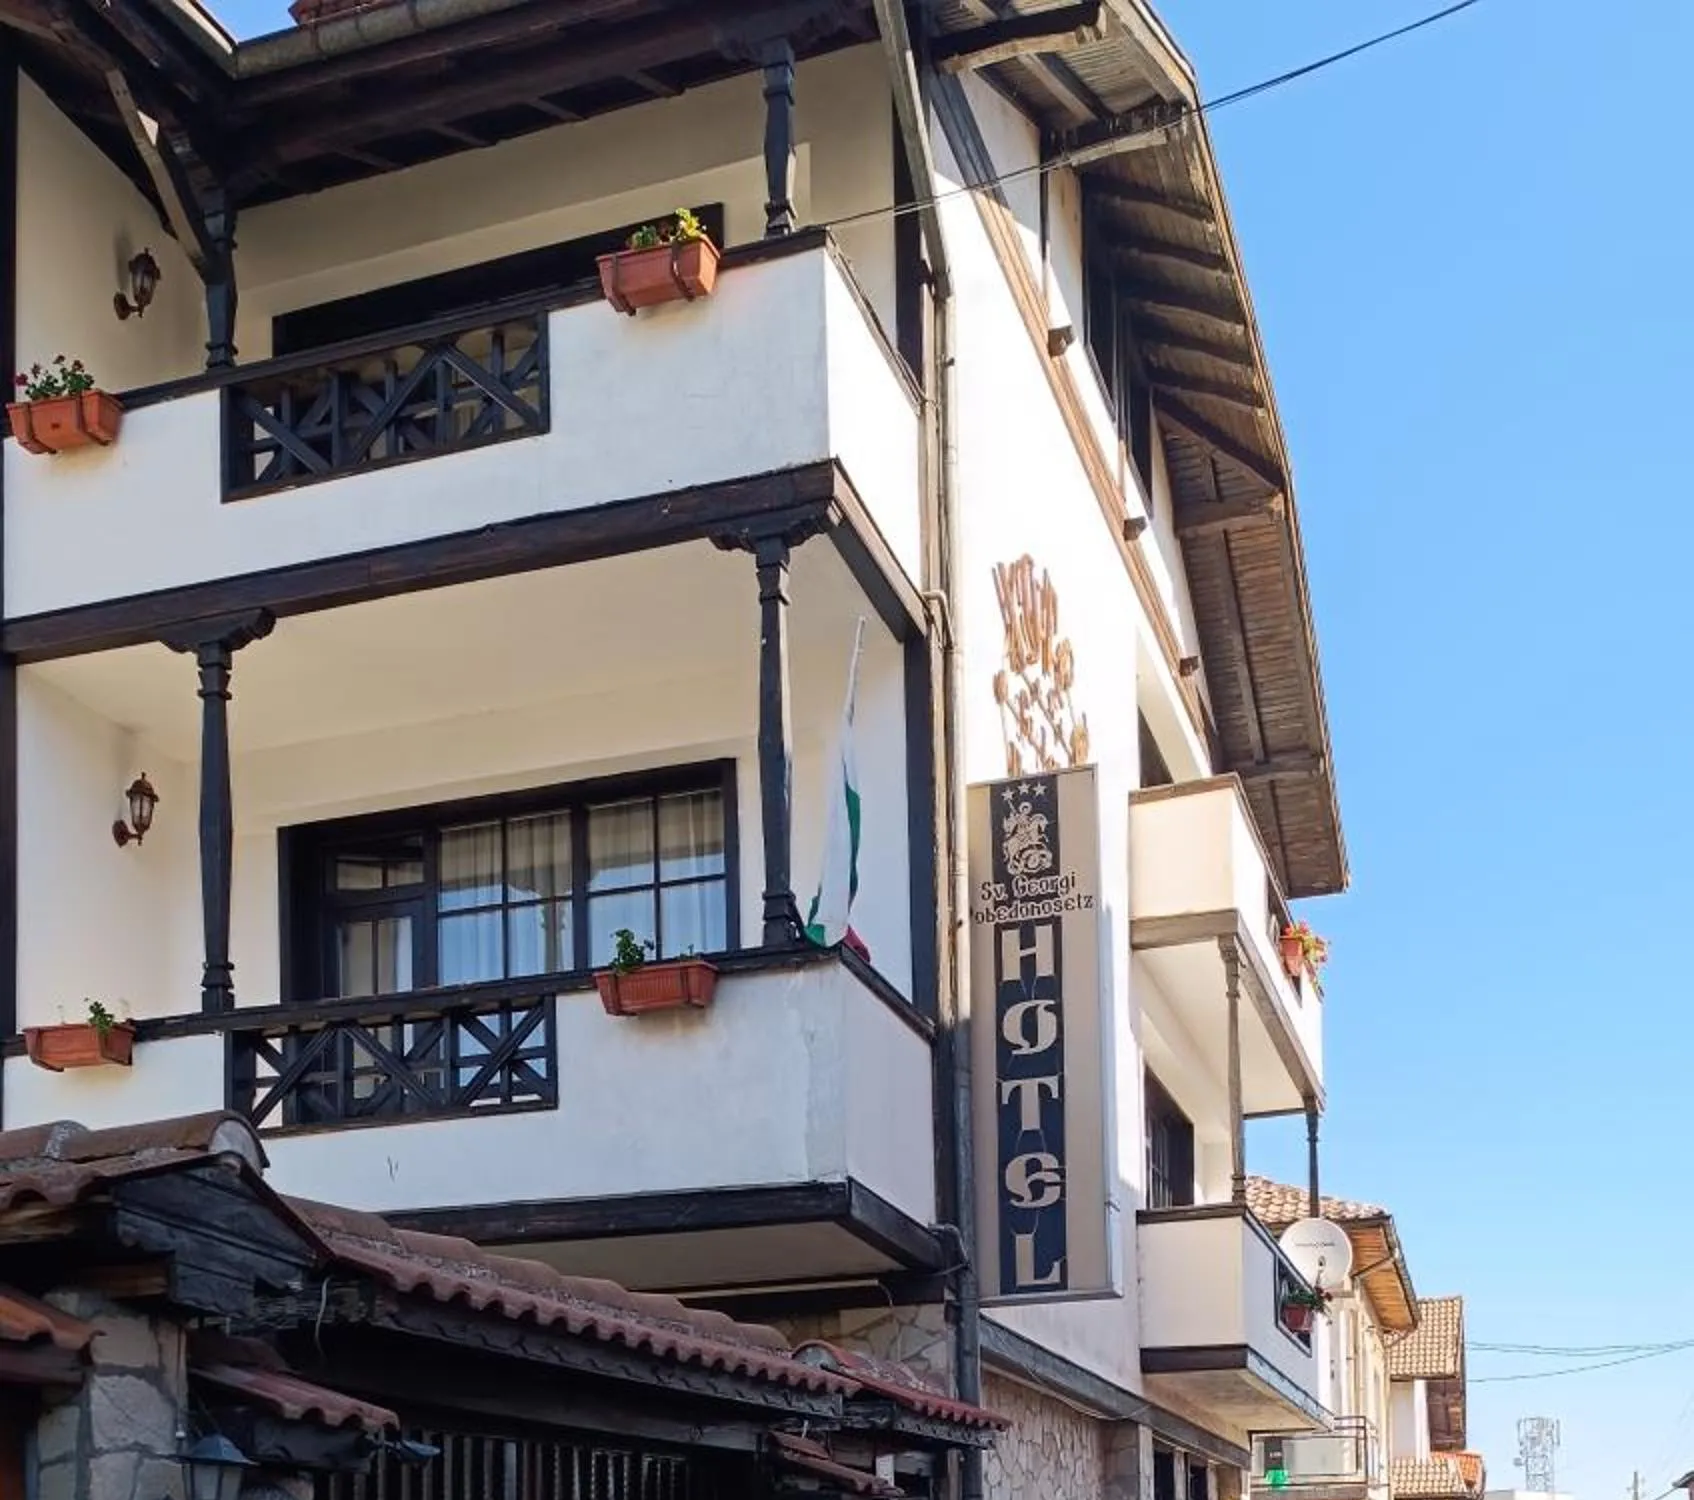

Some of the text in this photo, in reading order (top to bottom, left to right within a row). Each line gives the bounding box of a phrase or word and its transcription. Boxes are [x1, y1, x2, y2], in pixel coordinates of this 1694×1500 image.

[981, 871, 1076, 900] Sv. Georgi
[969, 892, 1093, 924] obedonosetz
[1001, 924, 1061, 1287] HOTEL
